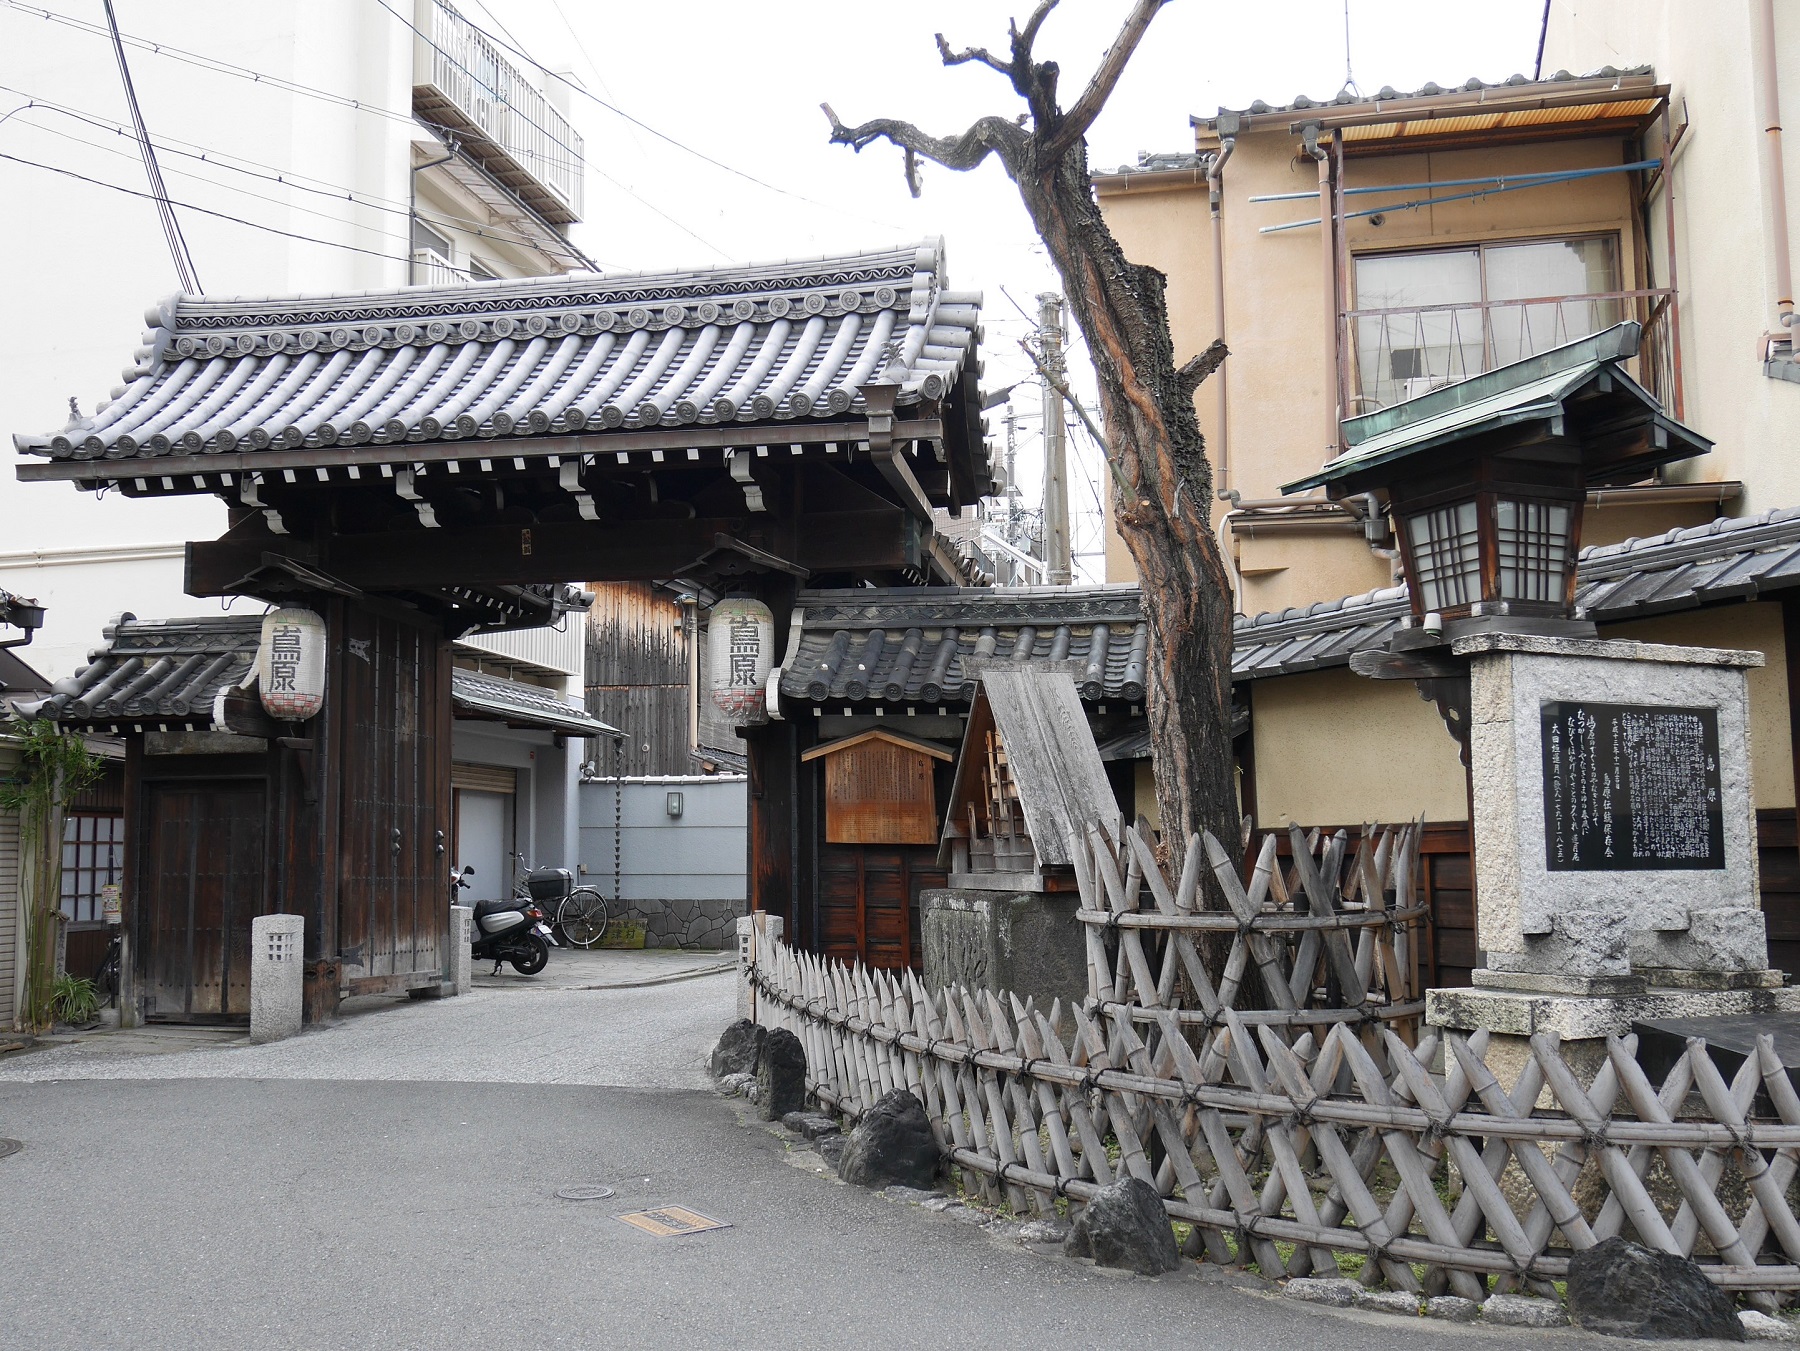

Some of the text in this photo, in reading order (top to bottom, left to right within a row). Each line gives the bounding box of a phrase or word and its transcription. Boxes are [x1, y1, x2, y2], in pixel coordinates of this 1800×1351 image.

[1706, 754, 1717, 802] 島原
[1601, 773, 1614, 858] 島原伝統保存会
